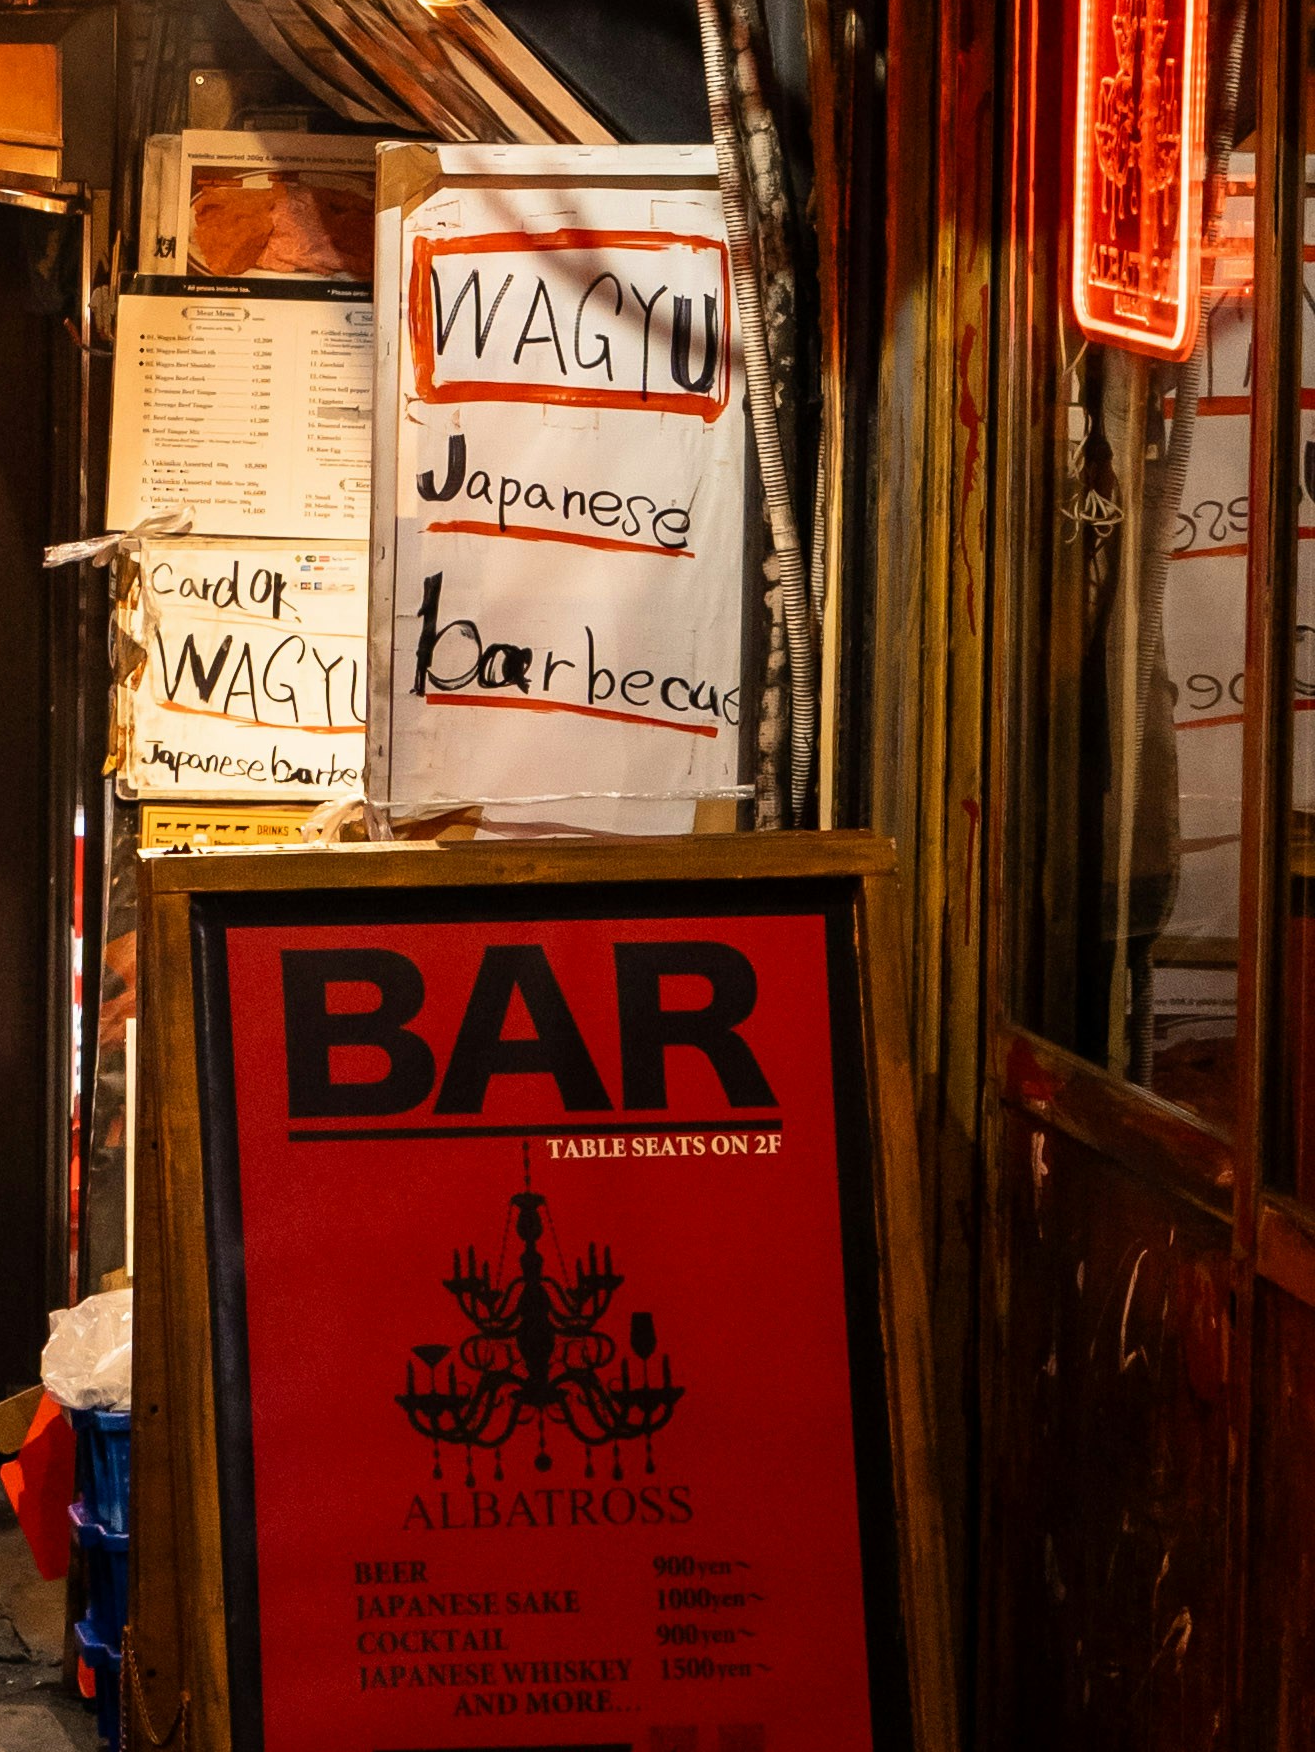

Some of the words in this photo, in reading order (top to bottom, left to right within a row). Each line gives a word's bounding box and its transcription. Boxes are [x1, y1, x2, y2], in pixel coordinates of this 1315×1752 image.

[431, 269, 719, 404] WAGYU
[416, 432, 691, 550] Japanese
[152, 560, 248, 611] Card
[154, 624, 367, 727] WAGYU
[141, 740, 266, 783] Japanese
[271, 745, 367, 787] barbe
[256, 824, 289, 837] DRINKS
[280, 940, 779, 1120] BAR
[547, 1137, 627, 1161] TABLE
[631, 1136, 707, 1159] SEATS
[712, 1135, 749, 1156] ON
[754, 1134, 782, 1155] 2F
[402, 1485, 695, 1532] ALBATROSS
[354, 1561, 429, 1585] BEER
[355, 1593, 501, 1621] JAPANESE
[506, 1590, 582, 1615] SAKE
[356, 1628, 509, 1656] COCKTAIL
[359, 1662, 497, 1692] JAPANESE
[503, 1658, 633, 1685] WHISKEY
[453, 1694, 518, 1718] AND
